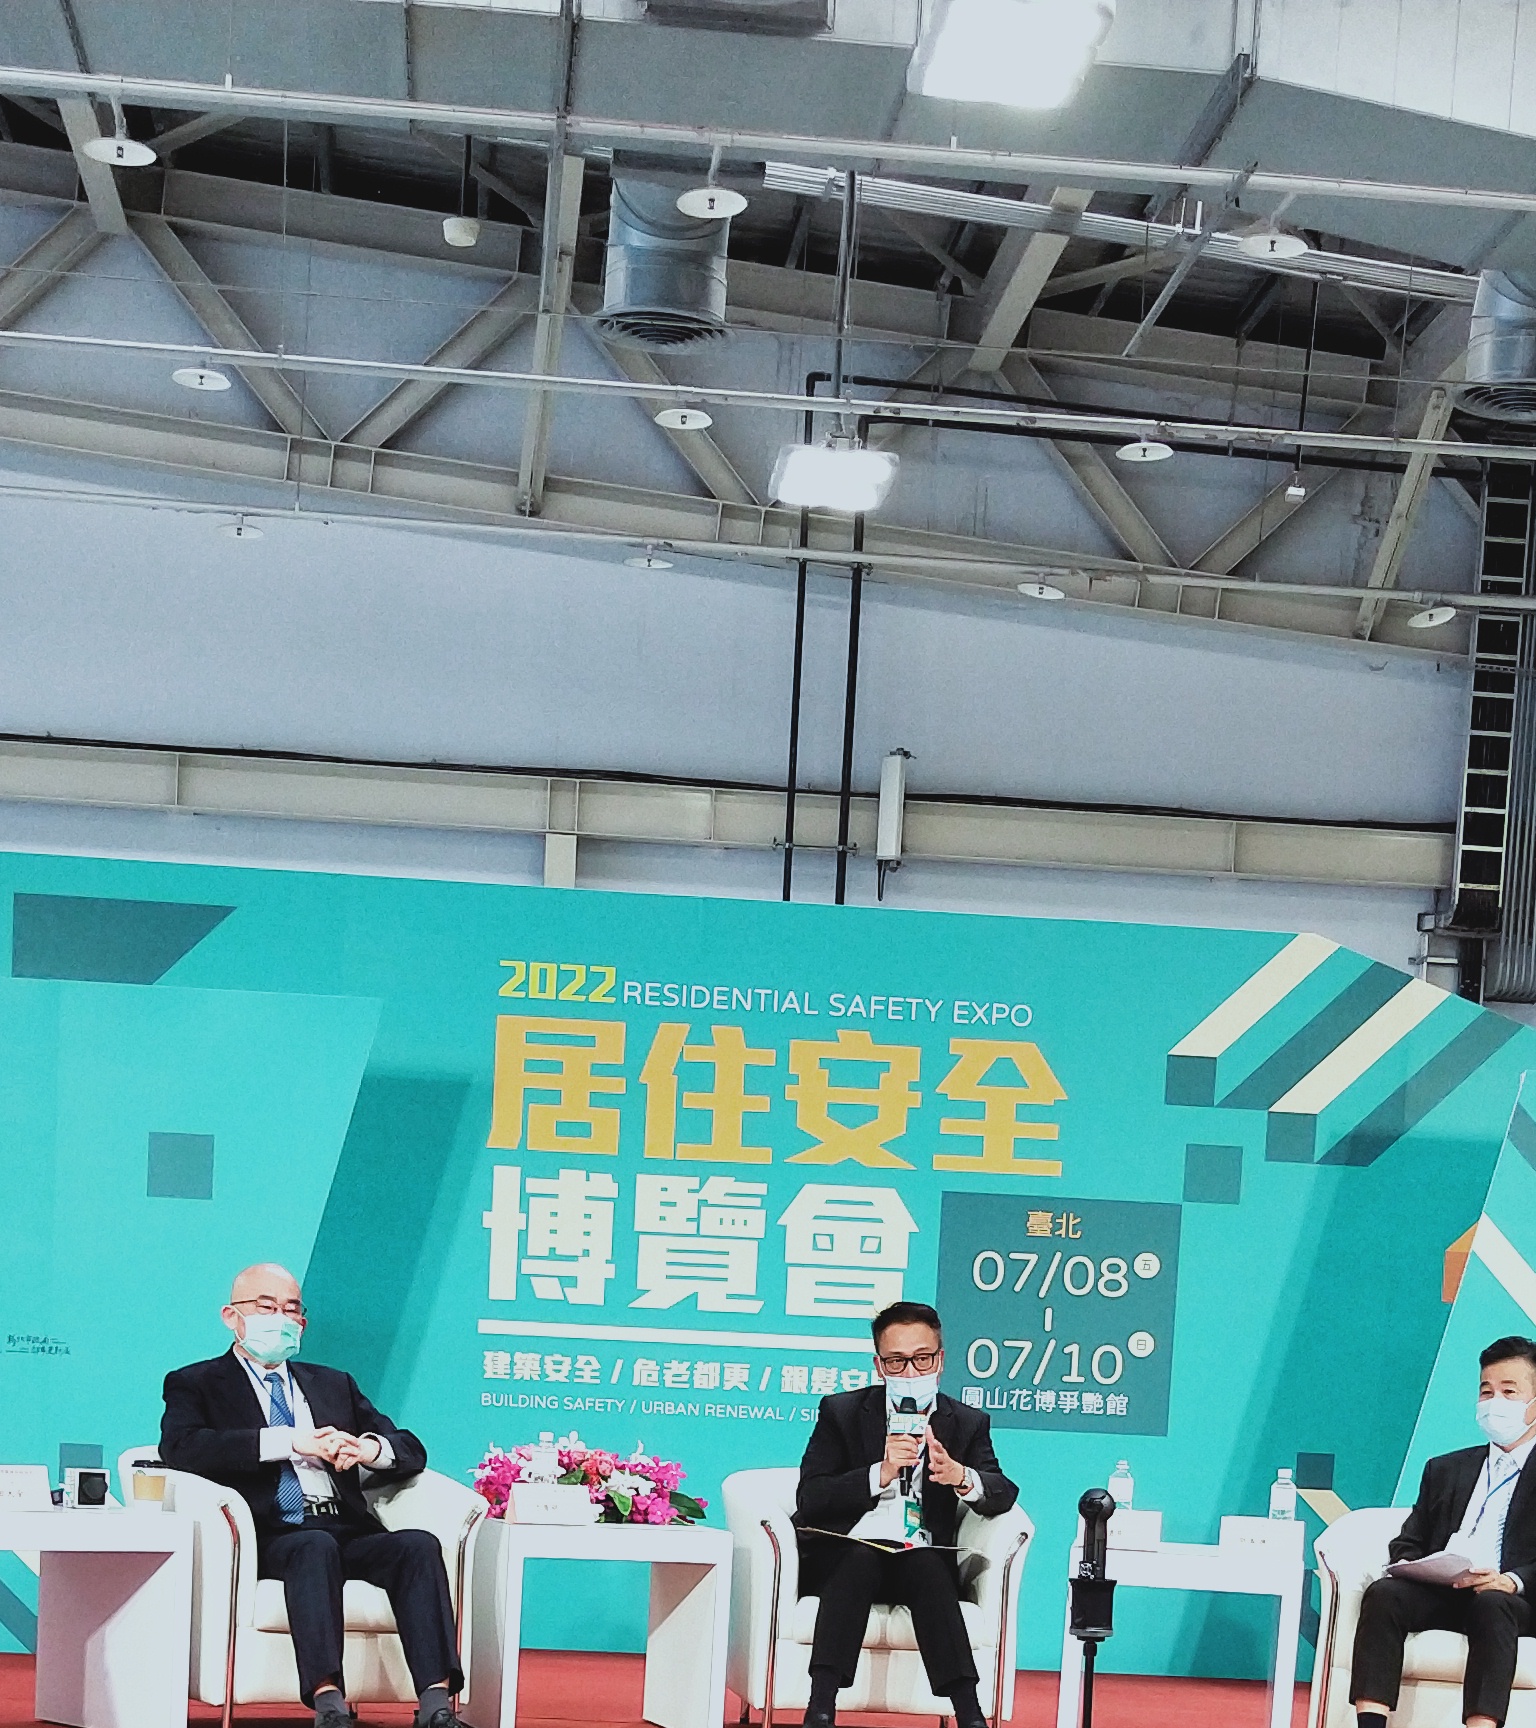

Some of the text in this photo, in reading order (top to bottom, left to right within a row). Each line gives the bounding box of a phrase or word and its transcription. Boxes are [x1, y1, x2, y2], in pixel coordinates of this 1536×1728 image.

[498, 960, 1034, 1028] 2022 RESIDENTIAL SAFETY EXPO
[485, 1014, 1069, 1178] 居住安全
[482, 1165, 921, 1318] 博覽會
[1026, 1210, 1082, 1239] 臺北
[972, 1250, 1129, 1299] 07/08
[482, 1350, 601, 1385] 建築安全
[632, 1359, 751, 1392] 危老都更
[966, 1338, 1124, 1385] 07/10
[481, 1392, 559, 1410] BUILDING
[562, 1396, 626, 1414] SAFETY
[641, 1400, 700, 1417] URBAN
[704, 1404, 785, 1421] RENEWAL
